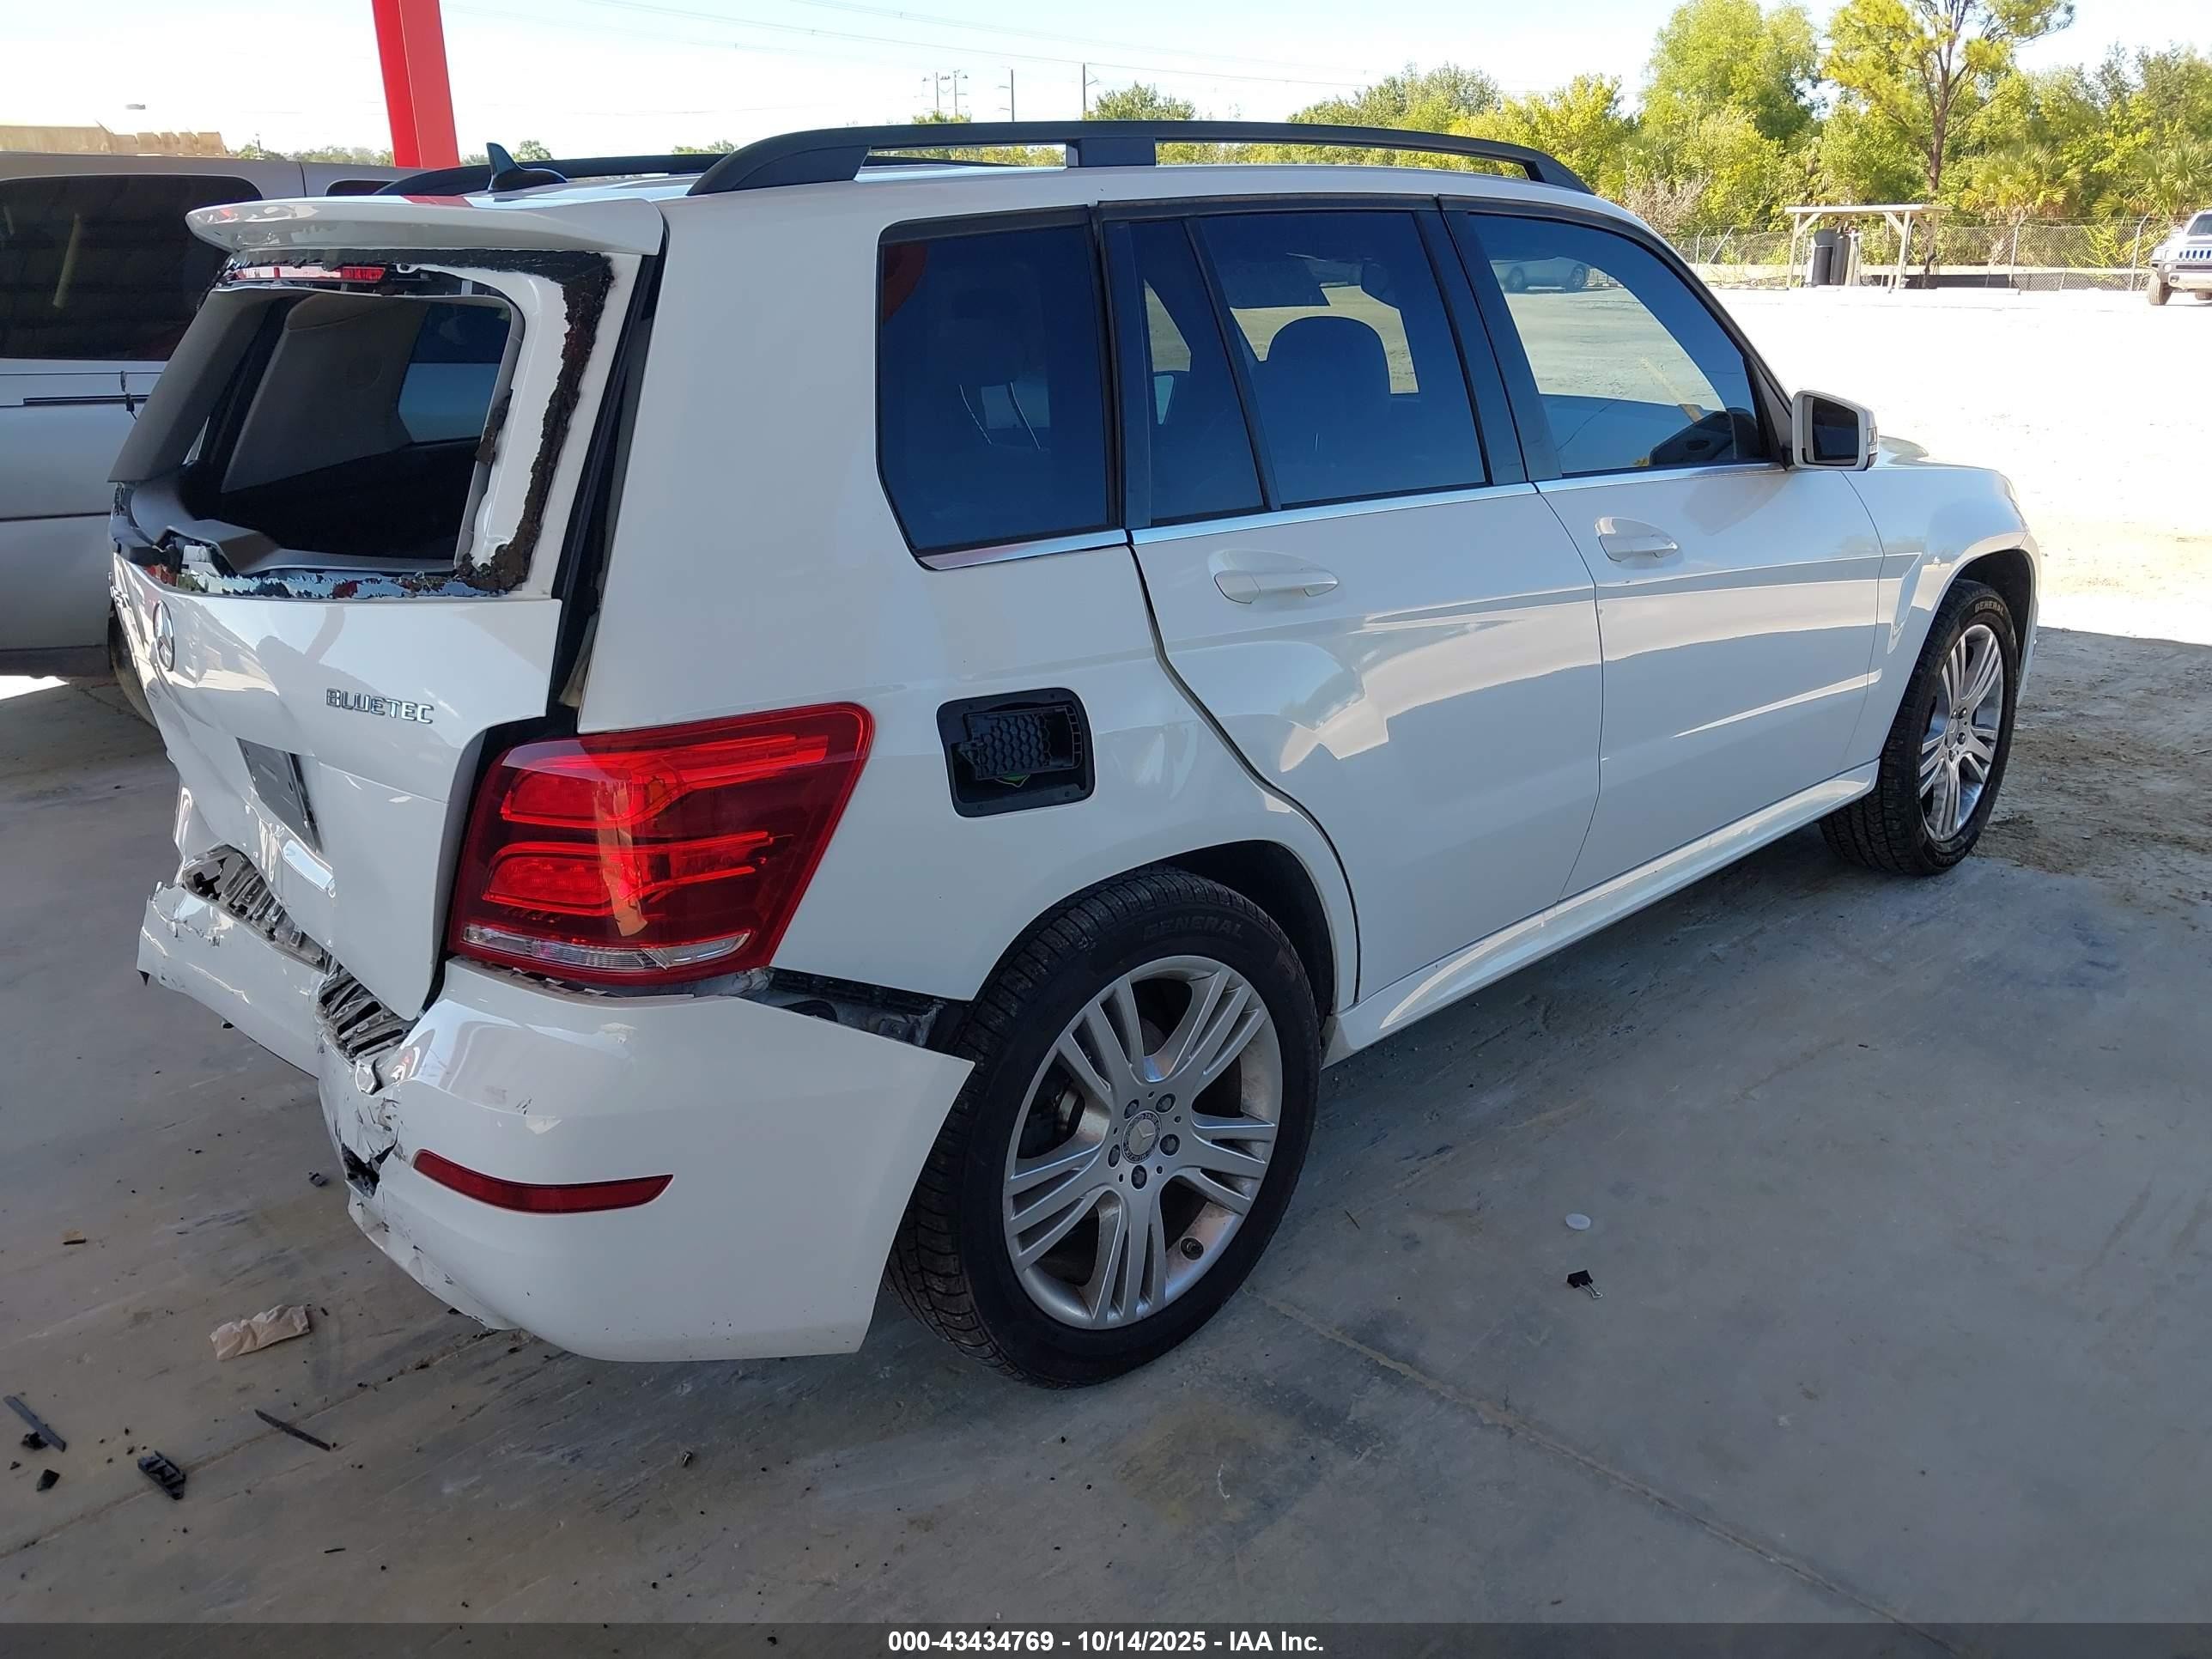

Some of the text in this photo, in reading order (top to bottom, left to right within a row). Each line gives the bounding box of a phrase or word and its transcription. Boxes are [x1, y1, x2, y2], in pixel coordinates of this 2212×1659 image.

[1974, 600, 2004, 617] GENERAL
[325, 688, 434, 725] BLUETEC
[1142, 915, 1243, 942] GENERAL
